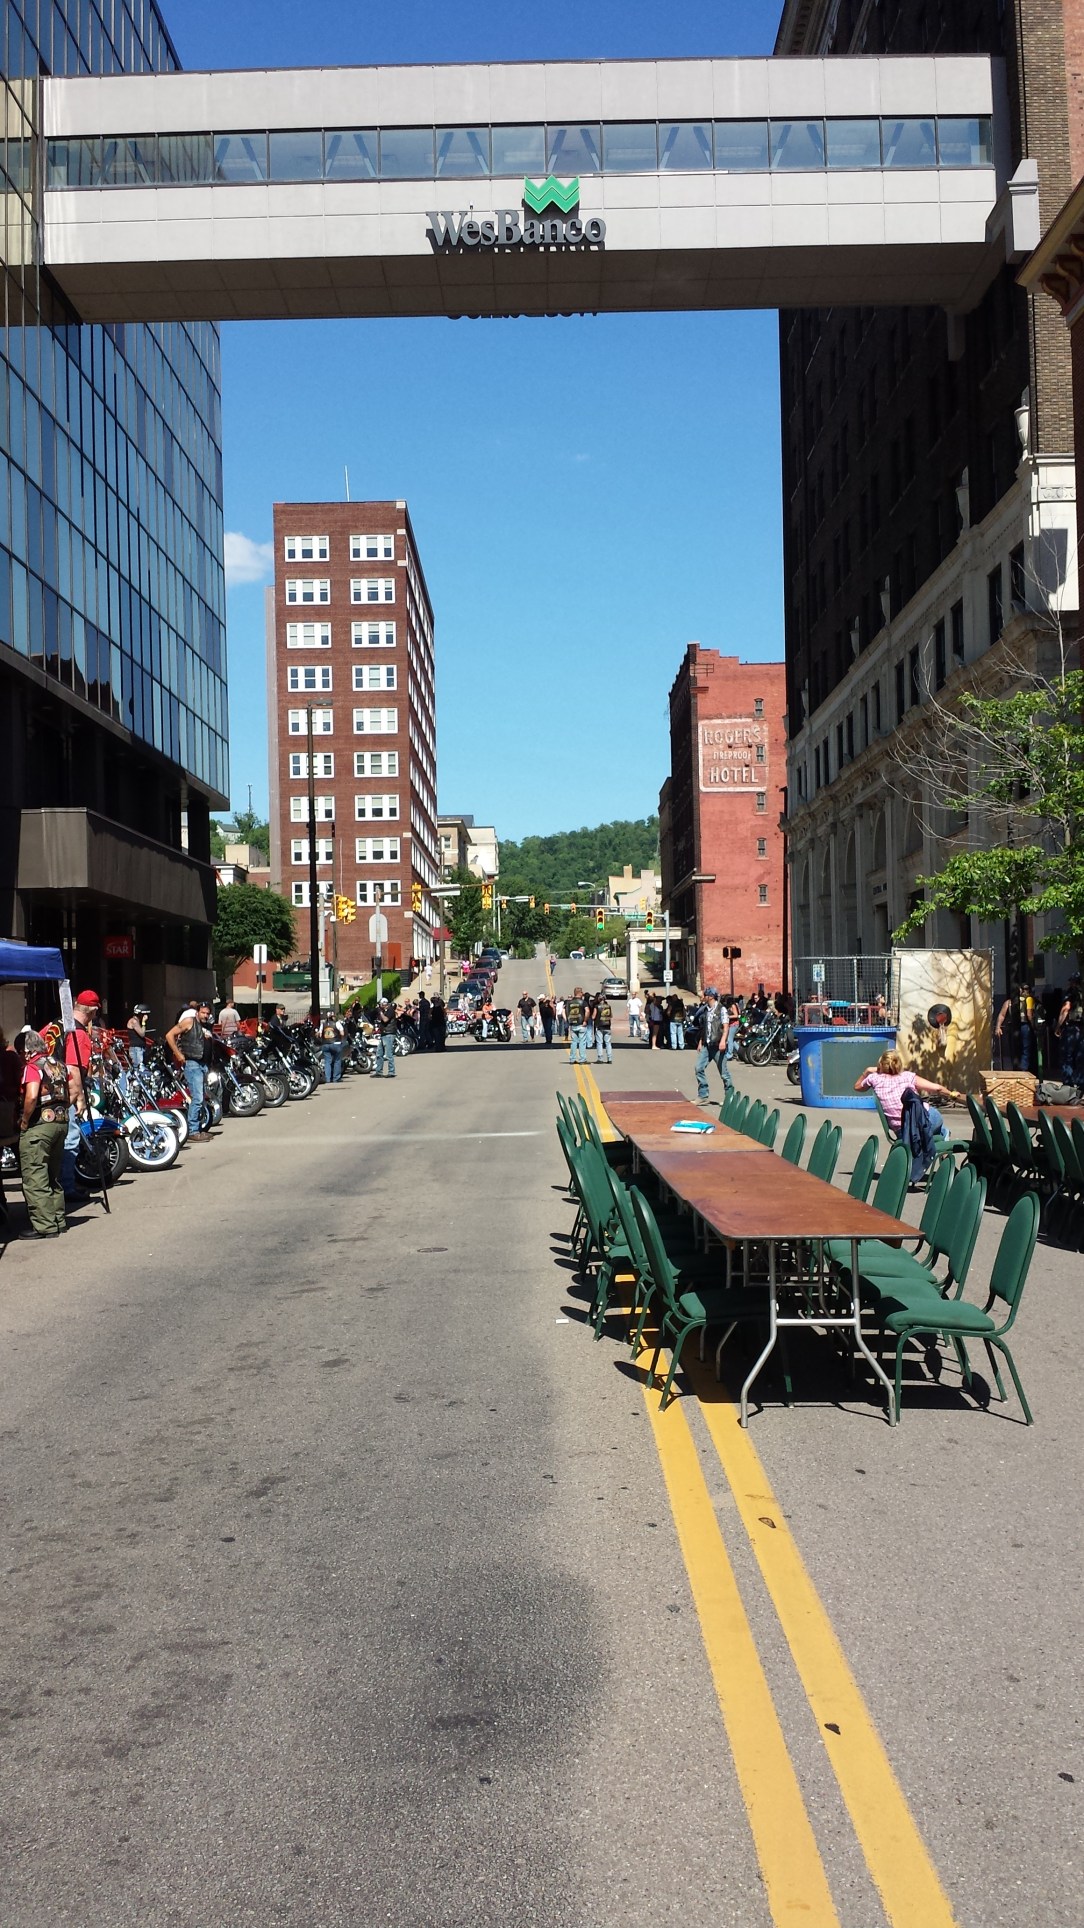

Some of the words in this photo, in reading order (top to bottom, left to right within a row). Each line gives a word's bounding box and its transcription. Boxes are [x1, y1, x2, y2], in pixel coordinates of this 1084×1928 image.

[426, 209, 607, 246] WesBanco
[710, 767, 759, 783] HOTEL
[106, 942, 129, 954] STAR
